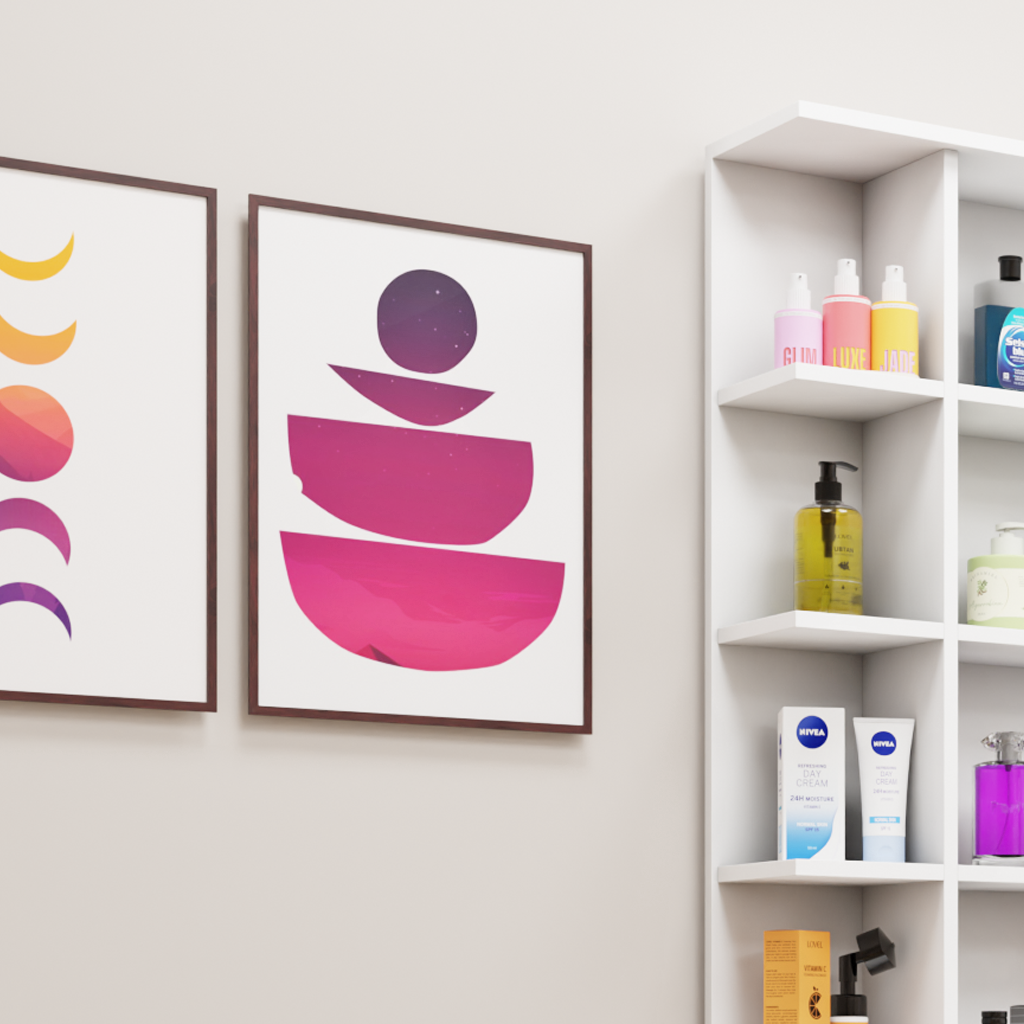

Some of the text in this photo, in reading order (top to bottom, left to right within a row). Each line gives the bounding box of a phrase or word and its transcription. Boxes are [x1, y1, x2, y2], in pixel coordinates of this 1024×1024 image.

[833, 347, 867, 370] LUXE
[880, 350, 915, 374] JADE
[799, 728, 826, 736] NIVEA
[873, 740, 895, 748] NIVEA
[803, 770, 822, 778] DAY
[796, 779, 828, 788] CREAM
